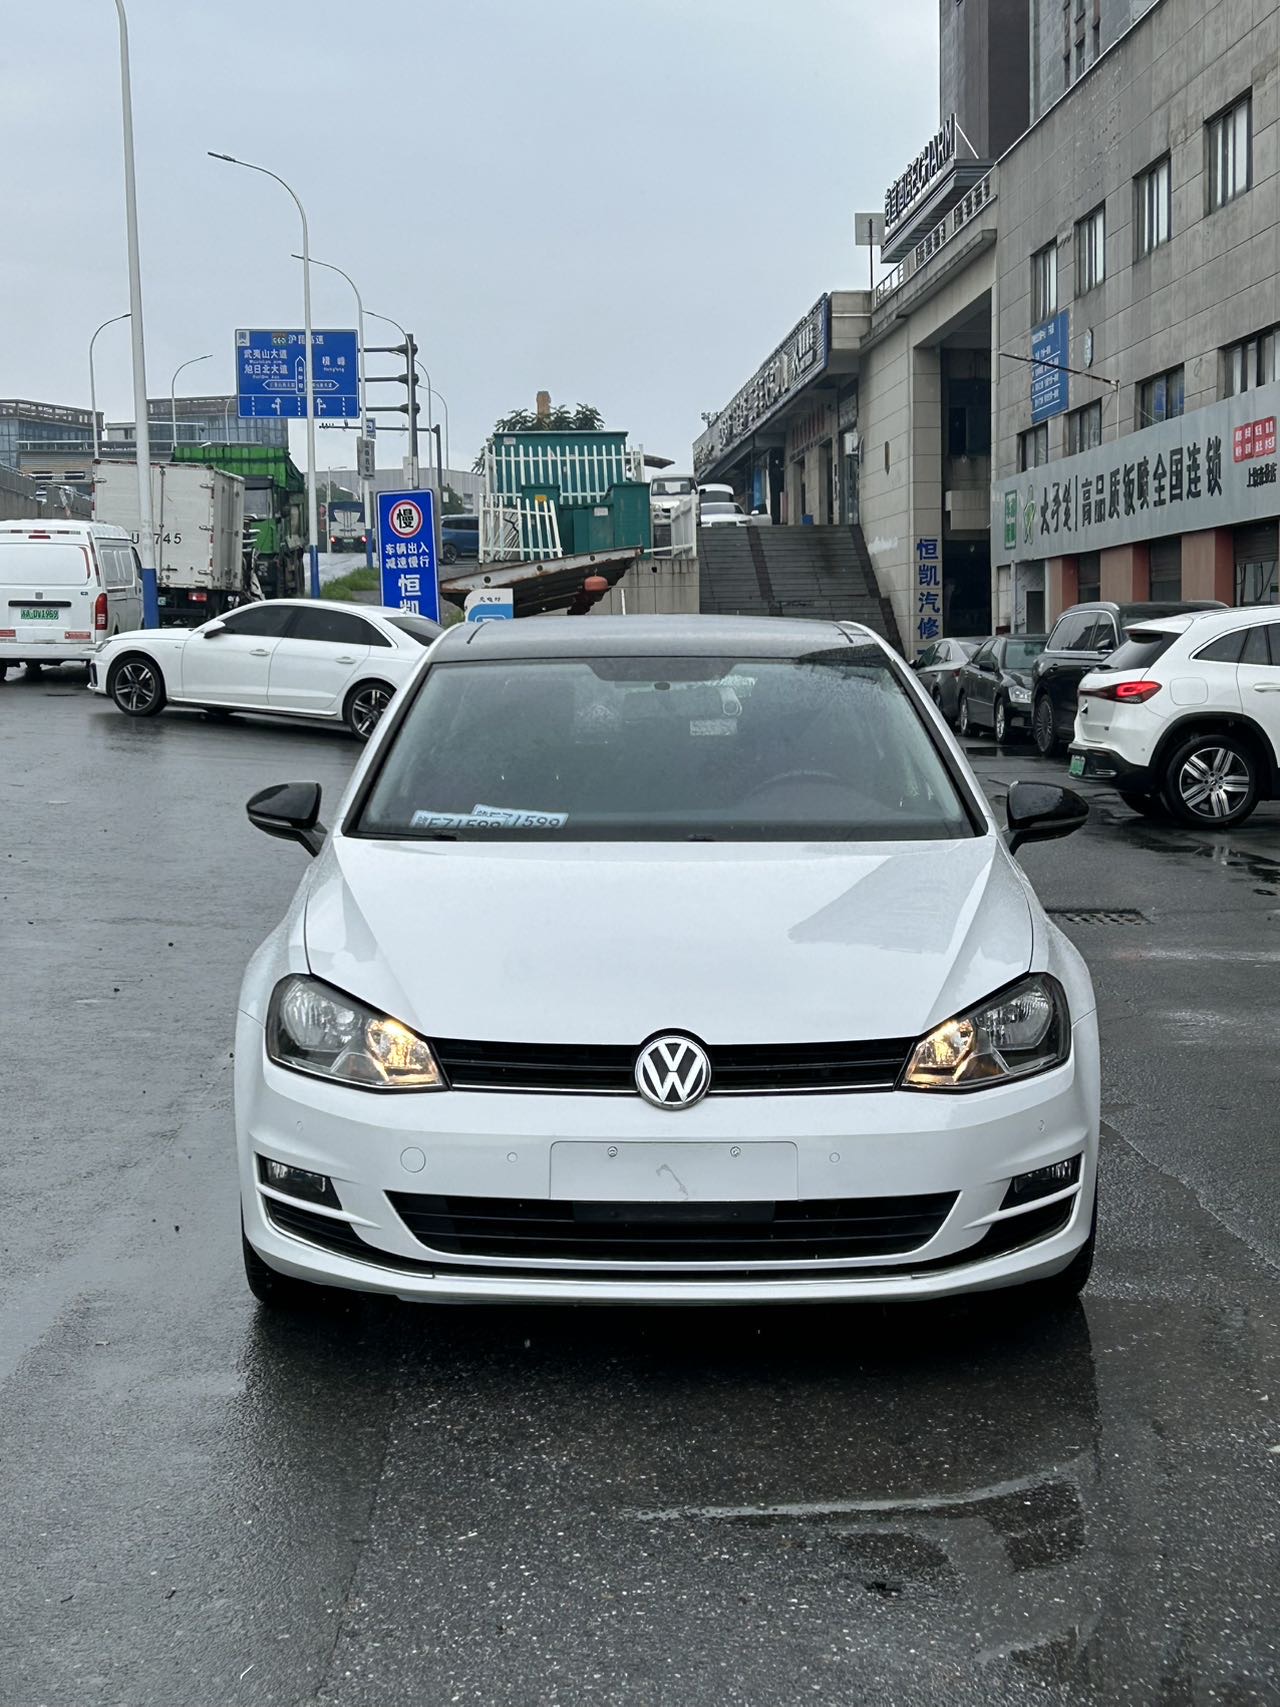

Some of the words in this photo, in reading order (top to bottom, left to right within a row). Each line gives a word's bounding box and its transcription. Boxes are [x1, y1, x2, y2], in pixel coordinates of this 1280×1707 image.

[243, 348, 288, 359] 武夷山大道
[244, 364, 289, 374] 旭日北大道
[396, 508, 414, 529] 慢
[385, 541, 429, 555] 车辆出入
[385, 555, 430, 569] 减速慢行
[917, 538, 941, 655] 恒凯汽修
[638, 1038, 708, 1107] VW
